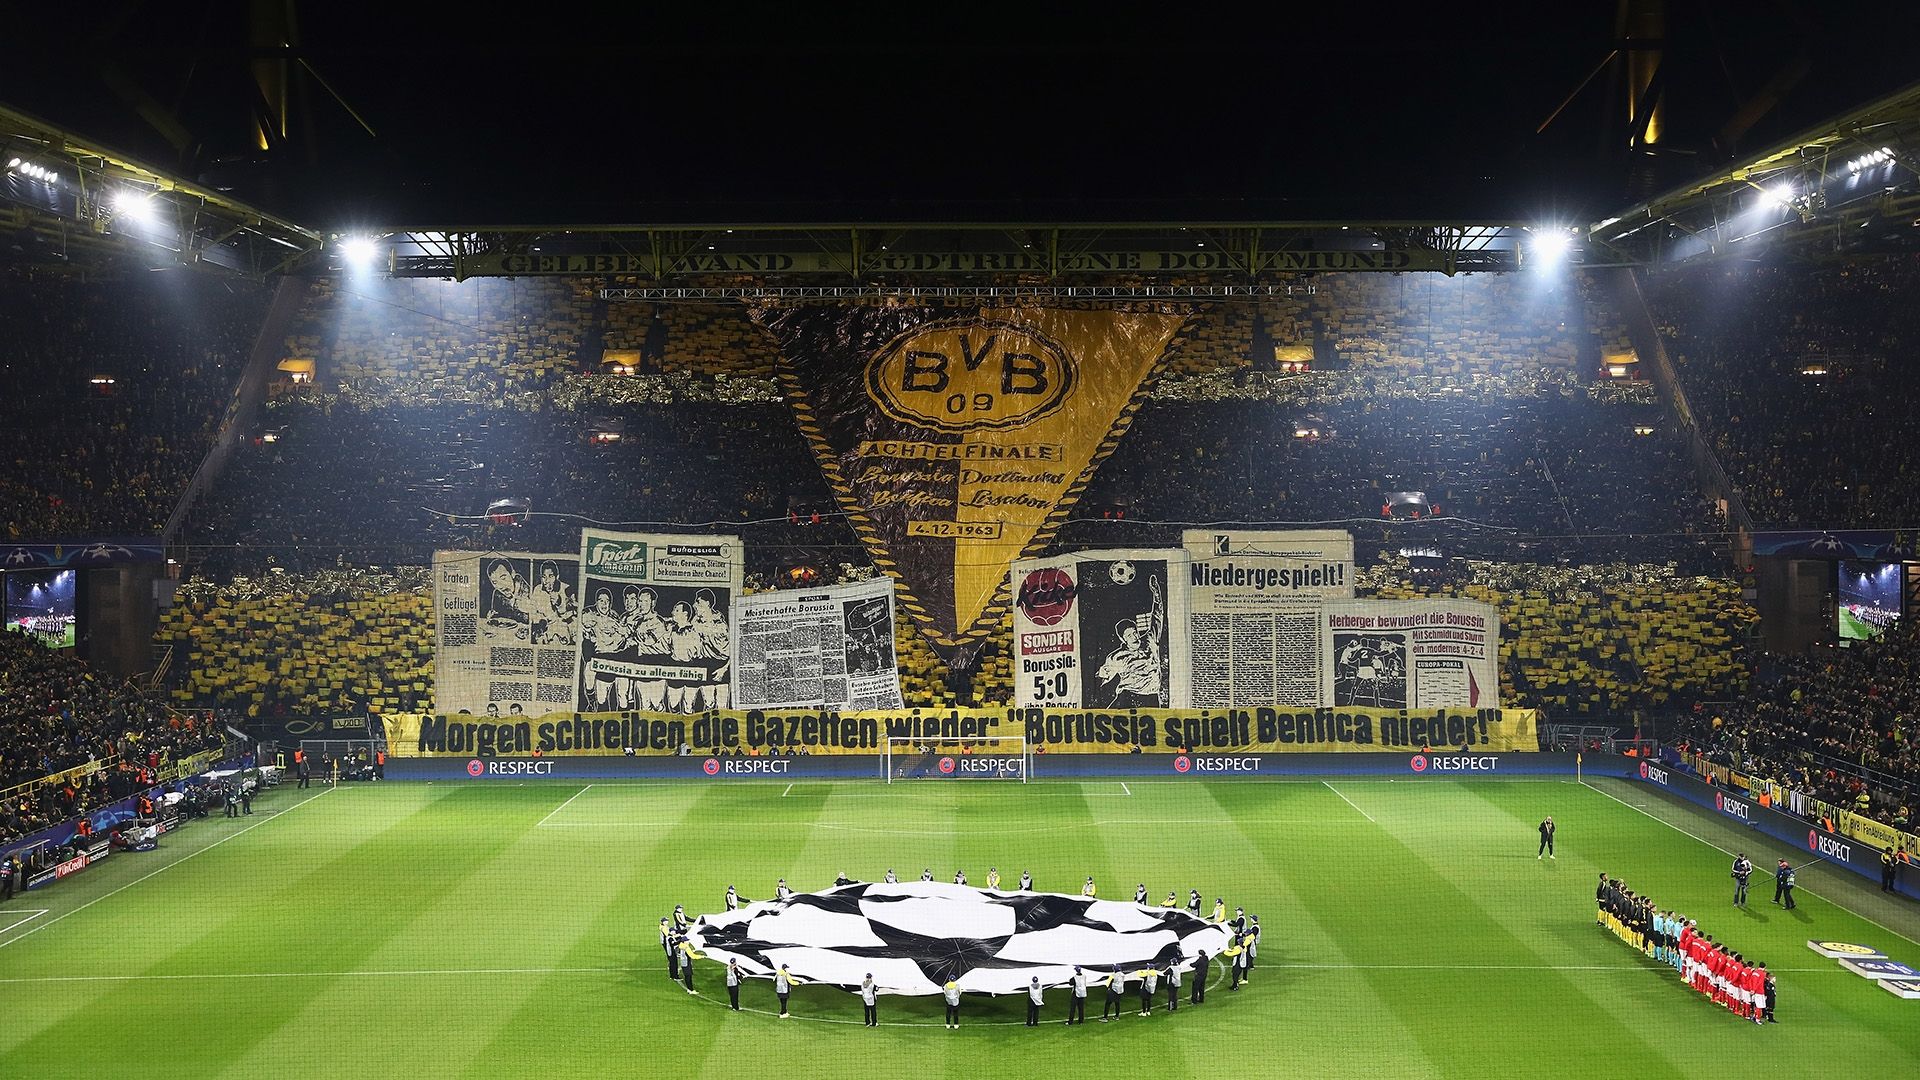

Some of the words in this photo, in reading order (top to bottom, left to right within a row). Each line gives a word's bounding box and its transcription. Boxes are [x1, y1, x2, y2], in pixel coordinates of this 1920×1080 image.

[501, 254, 642, 272] GELBE
[666, 254, 794, 272] WAND
[861, 251, 1141, 272] SÜDTRIBÜNE
[1158, 250, 1411, 271] DORTMUND
[902, 334, 1048, 395] BVB
[946, 393, 994, 414] 09
[863, 443, 1054, 460] ACHTELFINALE
[856, 465, 954, 485] Borussia
[961, 468, 1065, 486] Dortmund
[915, 523, 994, 536] 4.12.1963
[588, 542, 643, 567] Sport
[671, 546, 717, 554] BUNDESLIGA
[443, 571, 469, 584] Braten
[657, 568, 691, 578] bekommen
[1191, 562, 1344, 590] Niedergespielt!
[443, 597, 477, 612] Geflügel
[744, 604, 797, 617] Meisterhafte
[798, 602, 835, 612] Borussia
[1329, 614, 1376, 629] Herberger
[1378, 612, 1428, 628] bewundert
[1430, 611, 1444, 625] die
[1446, 612, 1485, 628] Borussia
[1023, 631, 1073, 649] SONDER
[1412, 630, 1423, 640] Mit
[1424, 630, 1452, 640] Schmidt
[1452, 630, 1464, 640] und
[1361, 650, 1369, 659] 2
[1412, 645, 1424, 654] ein
[1427, 644, 1461, 654] modernes
[1462, 645, 1484, 656] 4-2-4
[593, 660, 633, 675] Borussia
[635, 668, 647, 676] zu
[649, 667, 677, 678] allem
[679, 669, 704, 681] fähig
[1023, 655, 1077, 673] Borussia:
[1033, 672, 1068, 700] 5:0
[418, 715, 531, 758] Morgen
[537, 713, 685, 751] schreiben
[692, 709, 739, 748] die
[746, 708, 878, 749] Gazetten
[885, 709, 999, 748] wieder:
[1007, 708, 1157, 747] "Borussia
[1165, 710, 1250, 753] spielt
[1256, 707, 1373, 745] Benfica
[1380, 708, 1503, 746] nieder!"
[489, 761, 554, 775] RESPECT
[725, 760, 790, 773] RESPECT
[960, 758, 1024, 772] RESPECT
[1196, 757, 1261, 771] RESPECT
[1432, 756, 1498, 770] RESPECT
[1648, 765, 1668, 786] RESPECT
[1723, 796, 1749, 820] RESPECT
[1863, 820, 1895, 847] FanAbteilung
[1818, 835, 1851, 863] RESPECT
[62, 856, 84, 876] UniCredit
